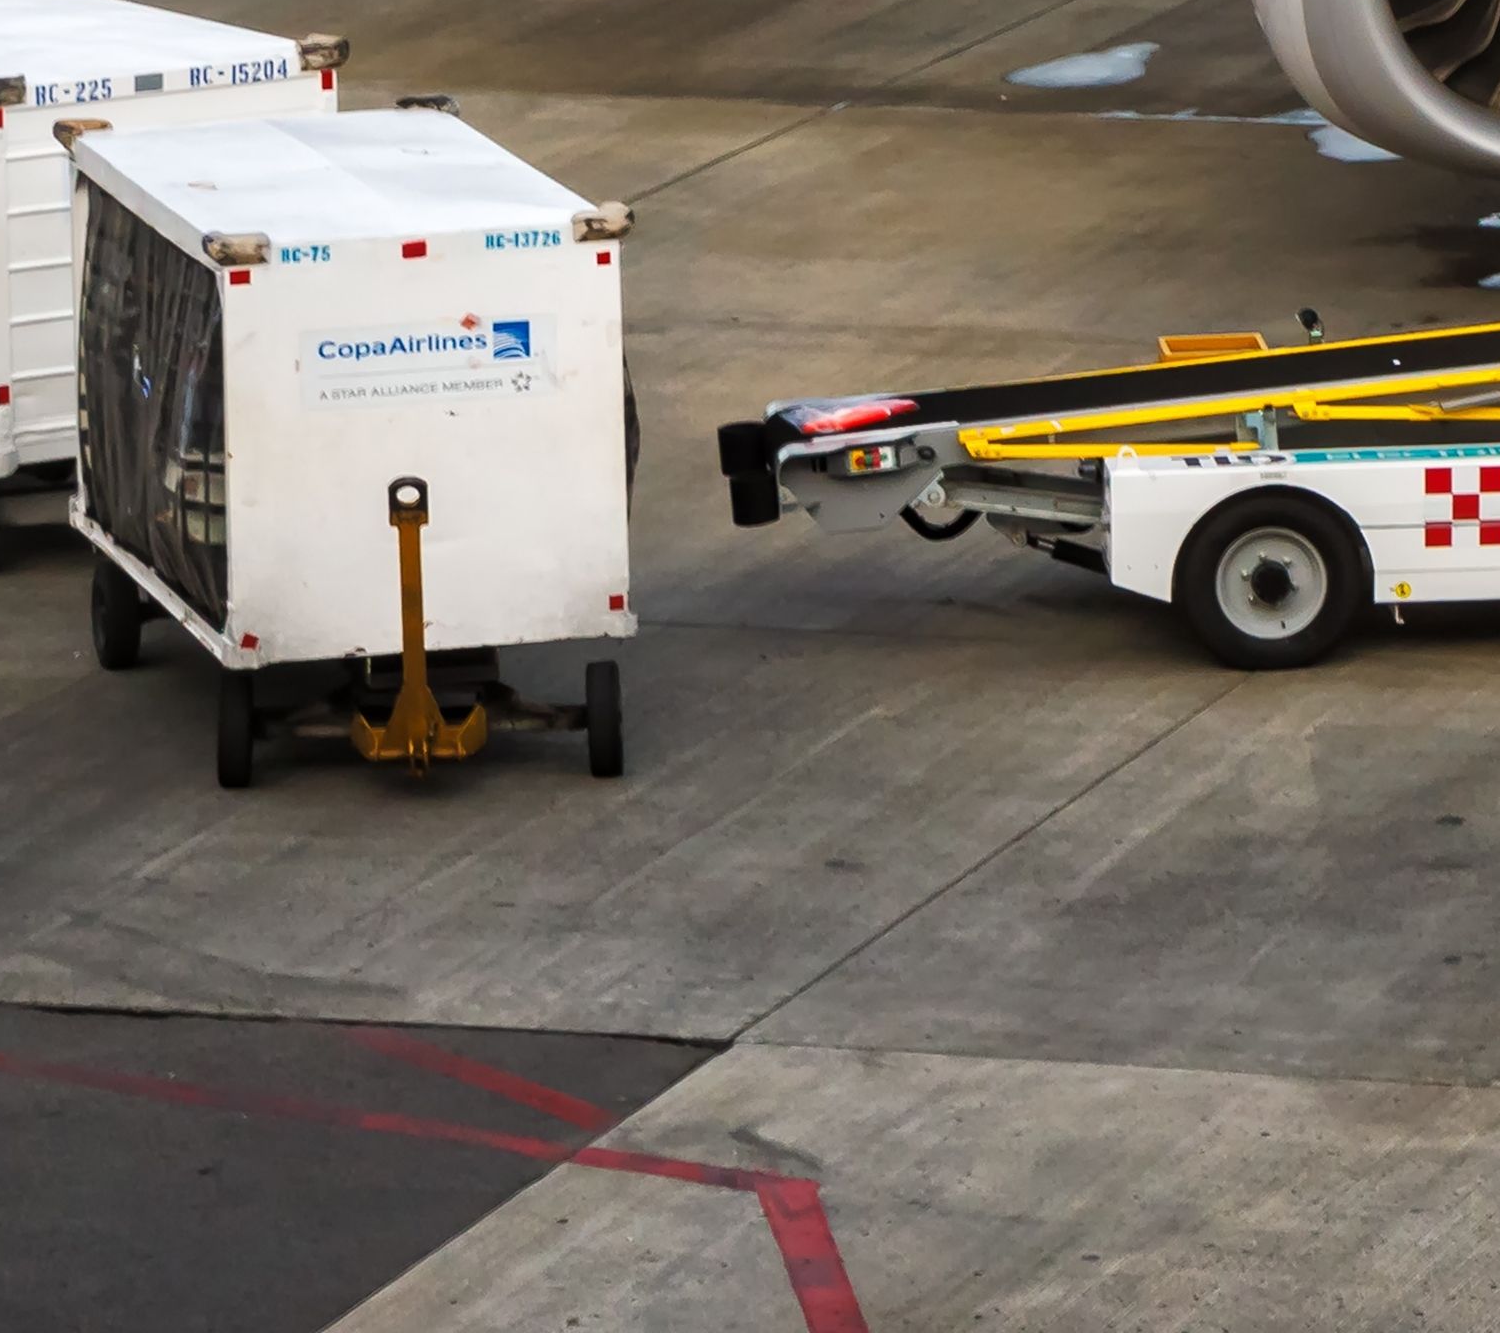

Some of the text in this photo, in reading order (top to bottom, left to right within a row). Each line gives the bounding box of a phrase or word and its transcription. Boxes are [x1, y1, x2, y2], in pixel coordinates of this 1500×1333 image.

[317, 332, 488, 361] CopaAirlines
[332, 388, 367, 400] STAR
[371, 383, 438, 398] ALLIANCE
[442, 379, 504, 393] MEMBER
